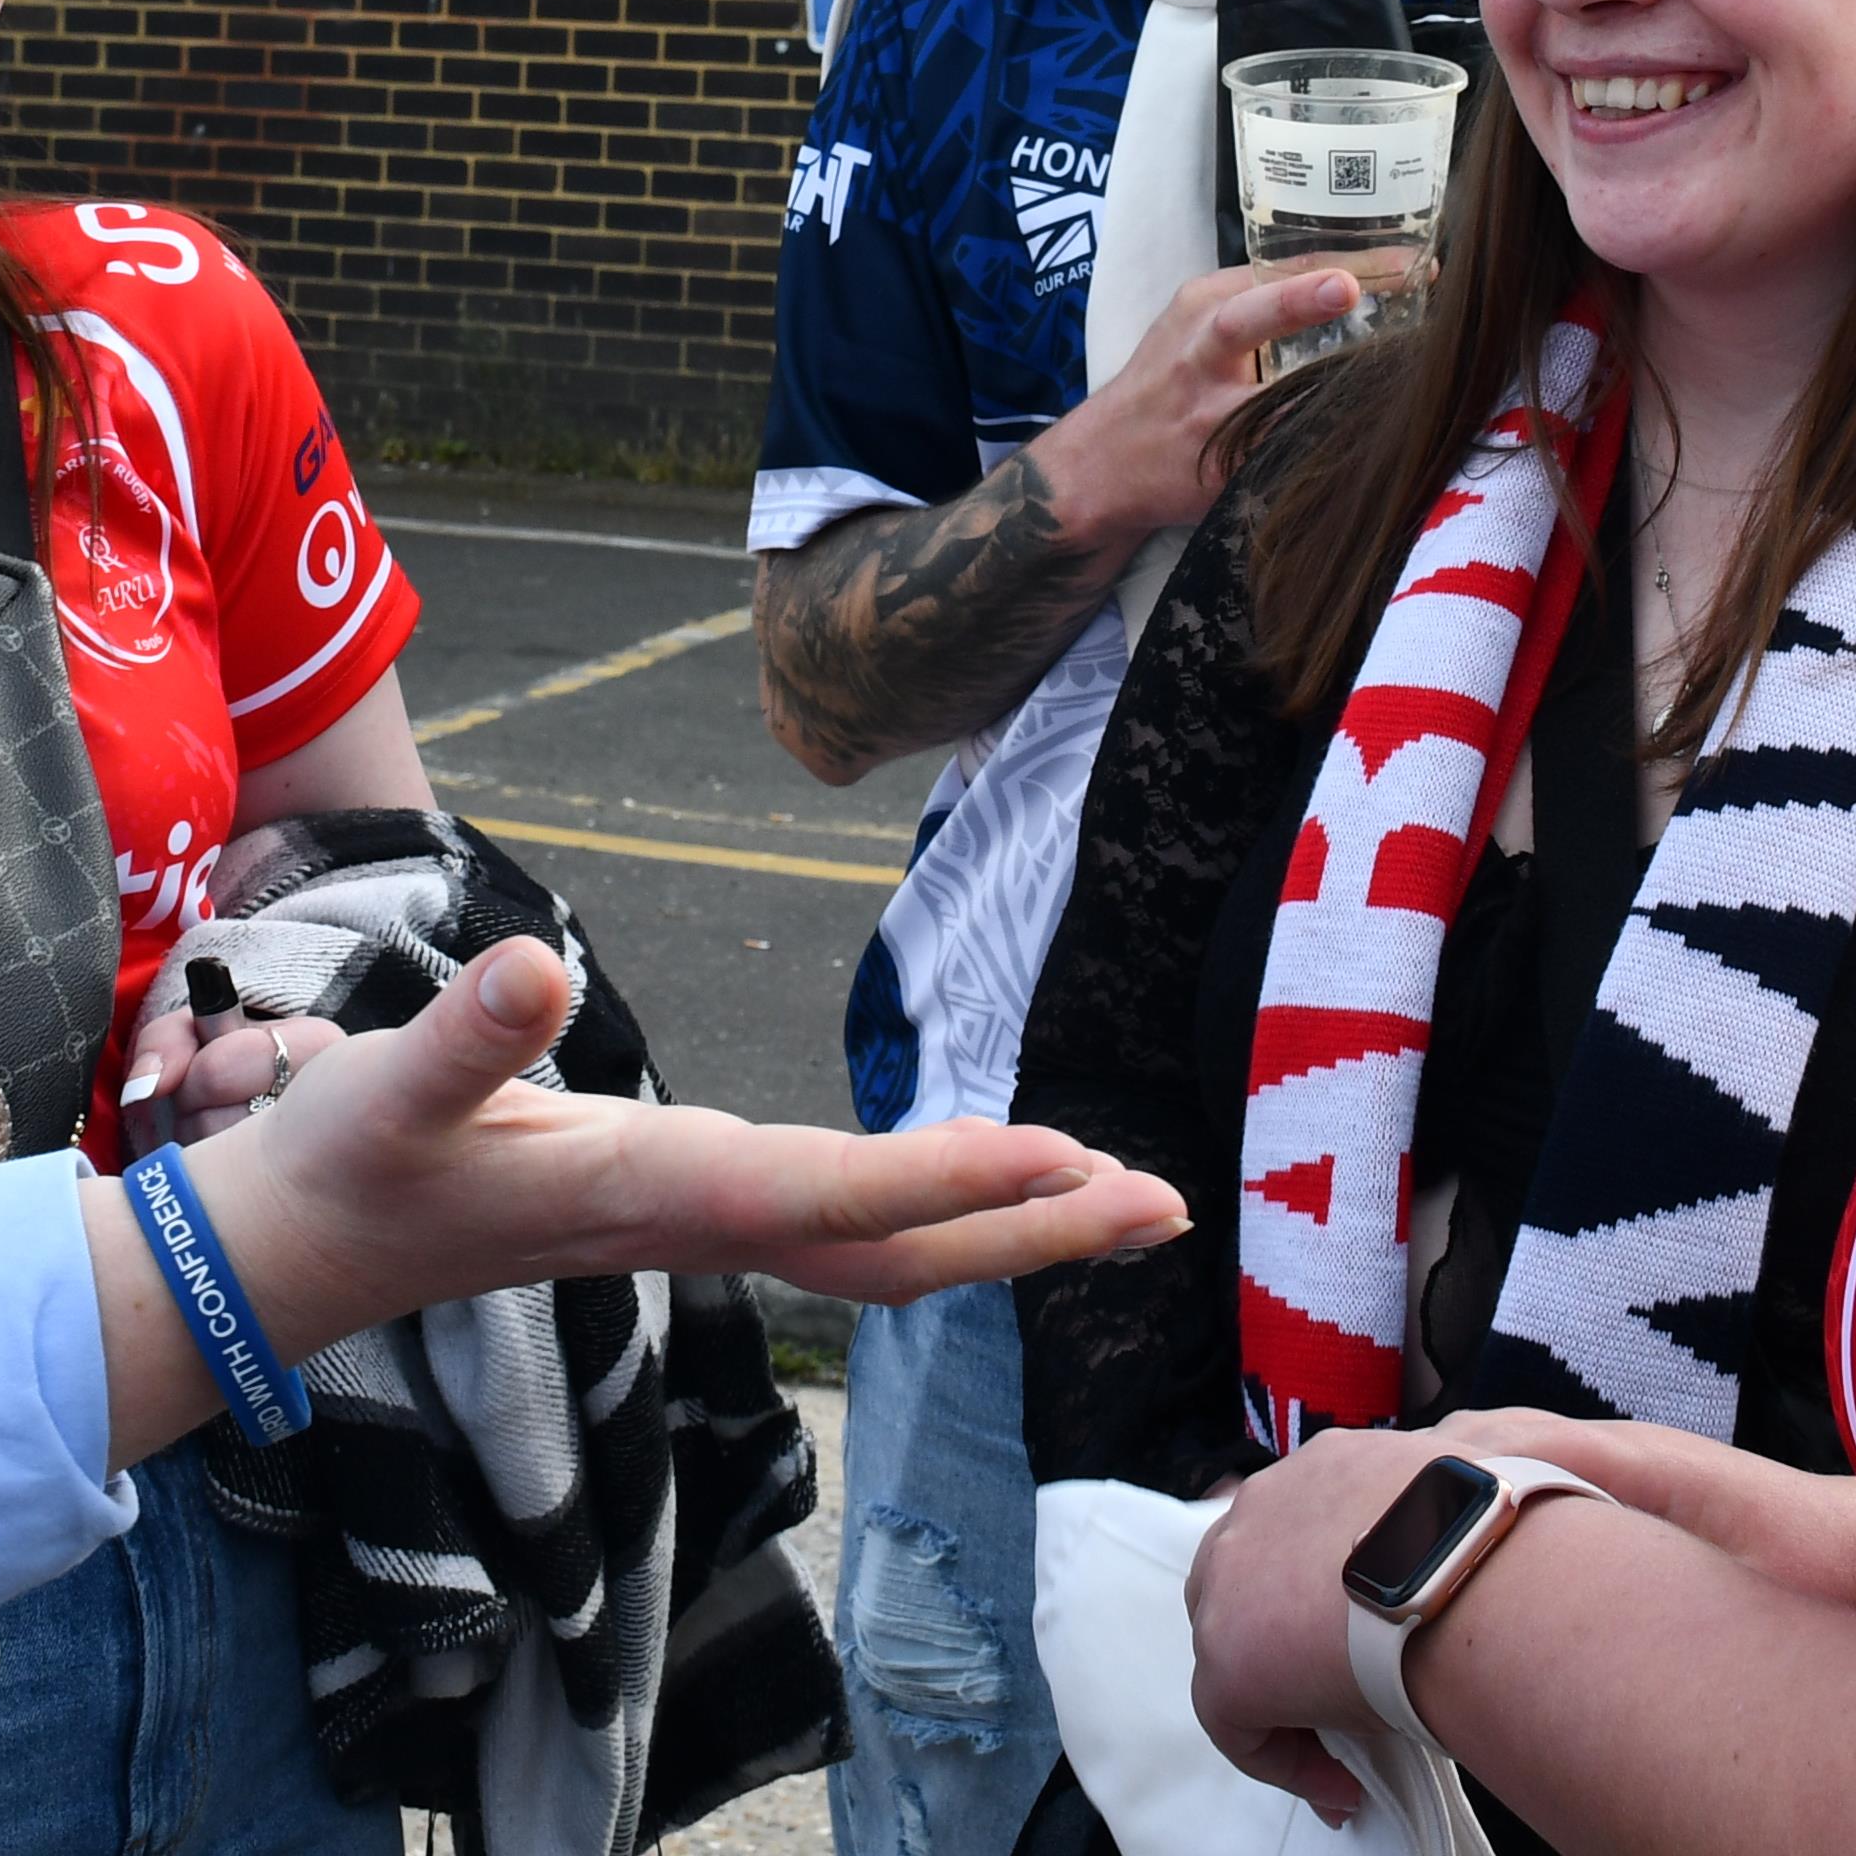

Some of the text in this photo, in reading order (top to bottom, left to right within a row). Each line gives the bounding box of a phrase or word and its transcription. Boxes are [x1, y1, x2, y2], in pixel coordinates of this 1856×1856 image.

[1034, 271, 1065, 297] OUR
[55, 453, 154, 515] ARMY RUGBY
[96, 573, 158, 616] ARU
[133, 633, 165, 652] 1906
[136, 1160, 238, 1339] CONFIDENCE
[221, 1340, 274, 1410] WITH
